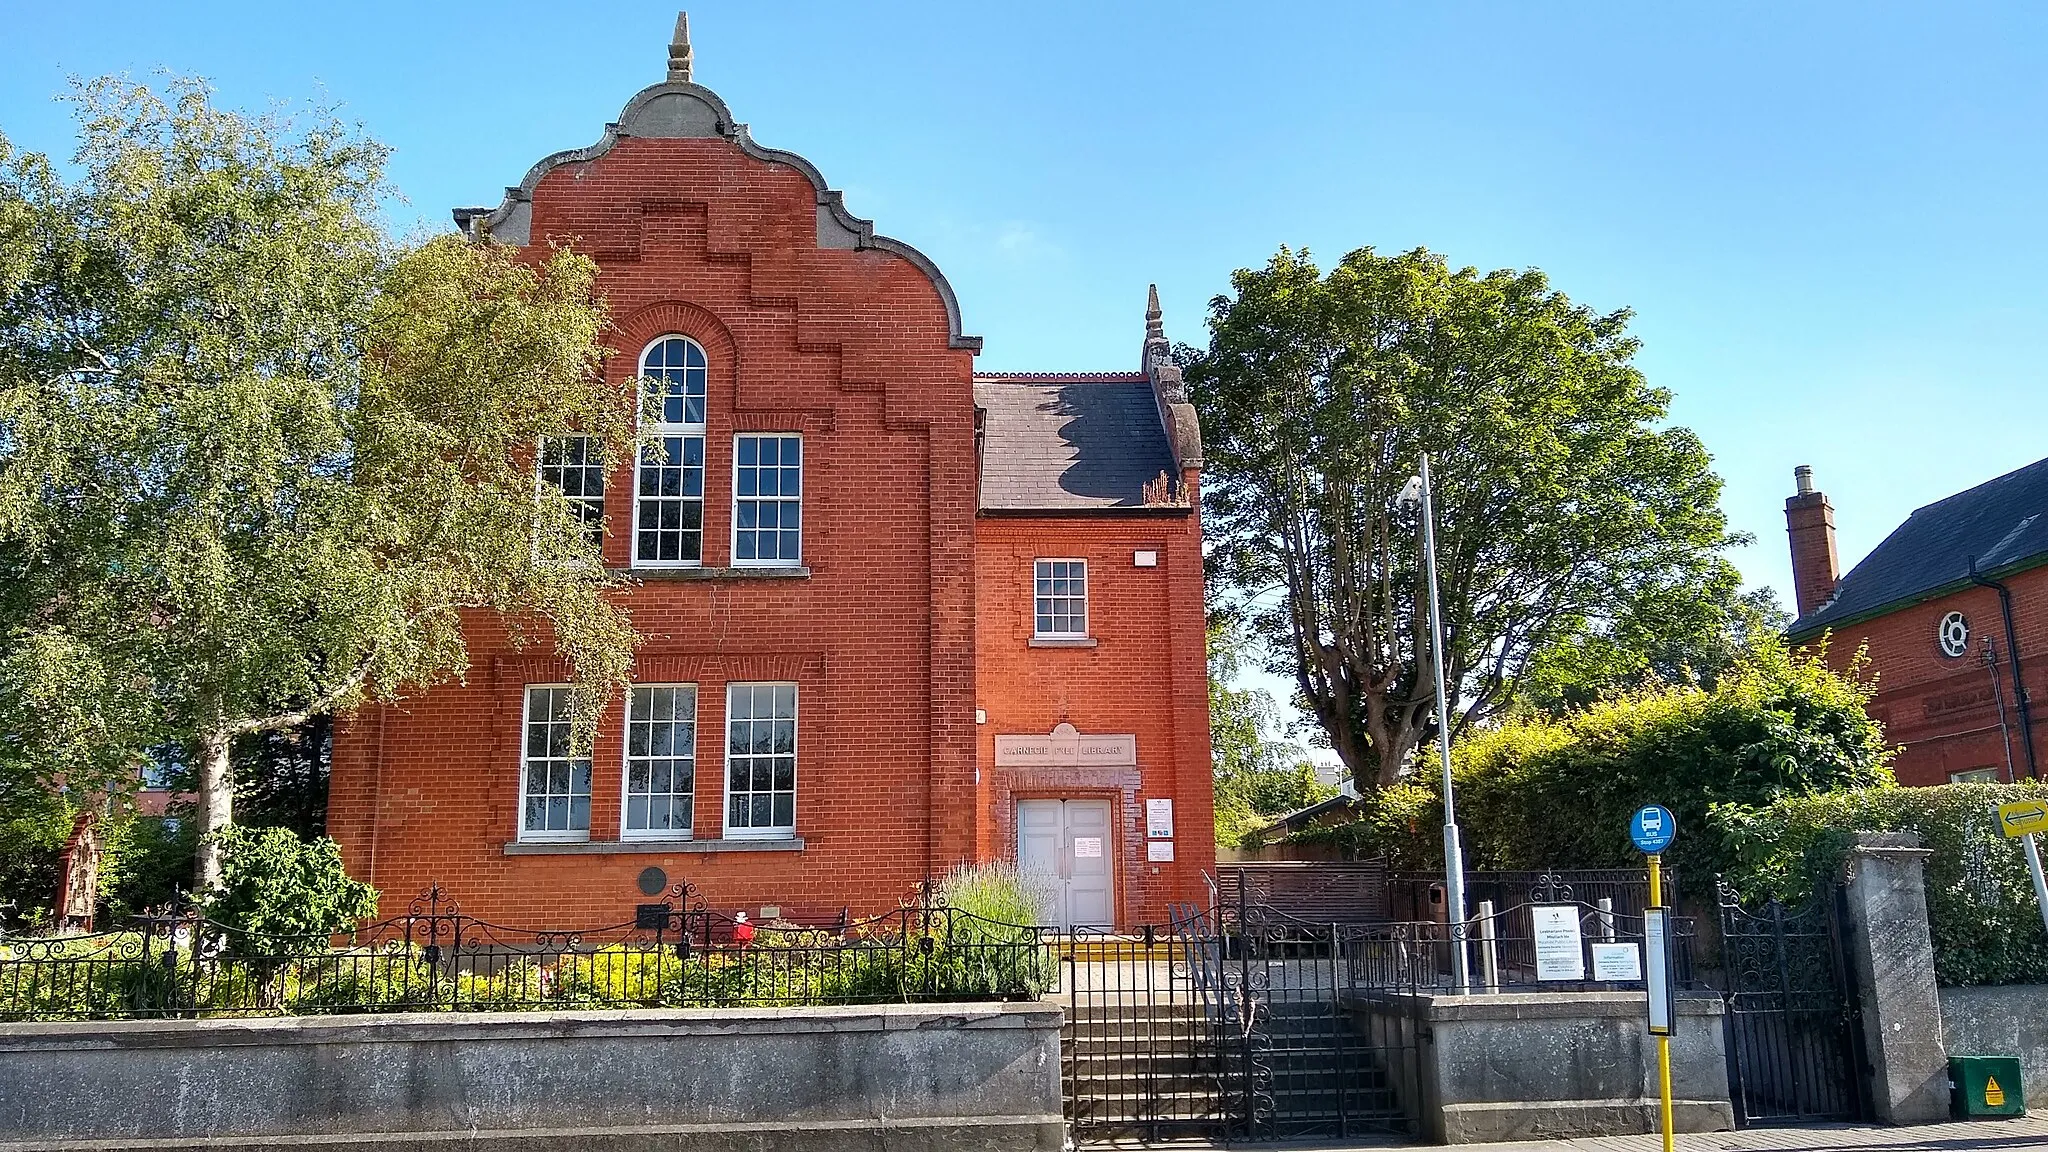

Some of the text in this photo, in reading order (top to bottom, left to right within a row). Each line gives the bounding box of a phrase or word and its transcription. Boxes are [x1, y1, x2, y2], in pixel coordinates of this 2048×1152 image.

[1003, 745, 1123, 755] CARNEGIE FREE LIBRARY
